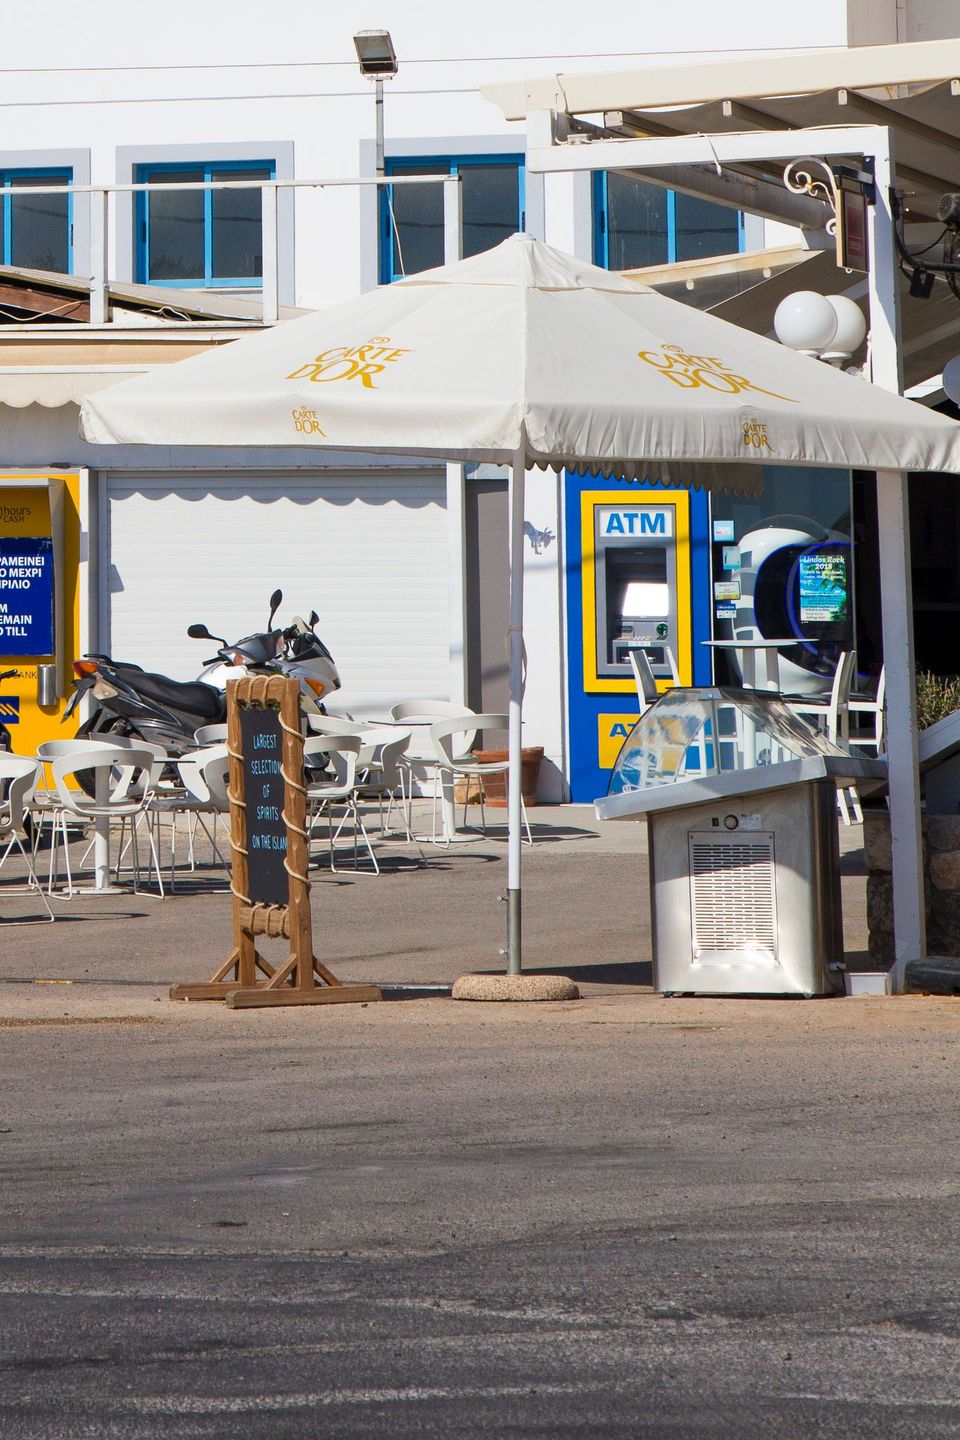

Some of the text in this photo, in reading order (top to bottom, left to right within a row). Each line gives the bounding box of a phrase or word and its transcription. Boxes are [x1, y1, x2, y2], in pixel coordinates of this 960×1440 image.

[315, 345, 416, 362] CARTE
[638, 351, 734, 371] CARTE
[658, 367, 801, 403] D'OR
[292, 409, 318, 420] CARTE
[294, 419, 328, 438] D'OR
[743, 422, 767, 434] CARTE
[3, 505, 31, 516] hours
[605, 512, 665, 534] ATM
[827, 556, 845, 564] Rock
[9, 568, 42, 577] ΜΕΧΡΙ
[6, 626, 27, 636] TILL
[14, 671, 38, 681] ANK
[253, 735, 277, 749] LARGEST
[250, 760, 281, 775] SELECTION
[262, 784, 270, 799] OF
[256, 806, 279, 822] SPIRITS
[252, 835, 288, 851] ON THE ISLAN
